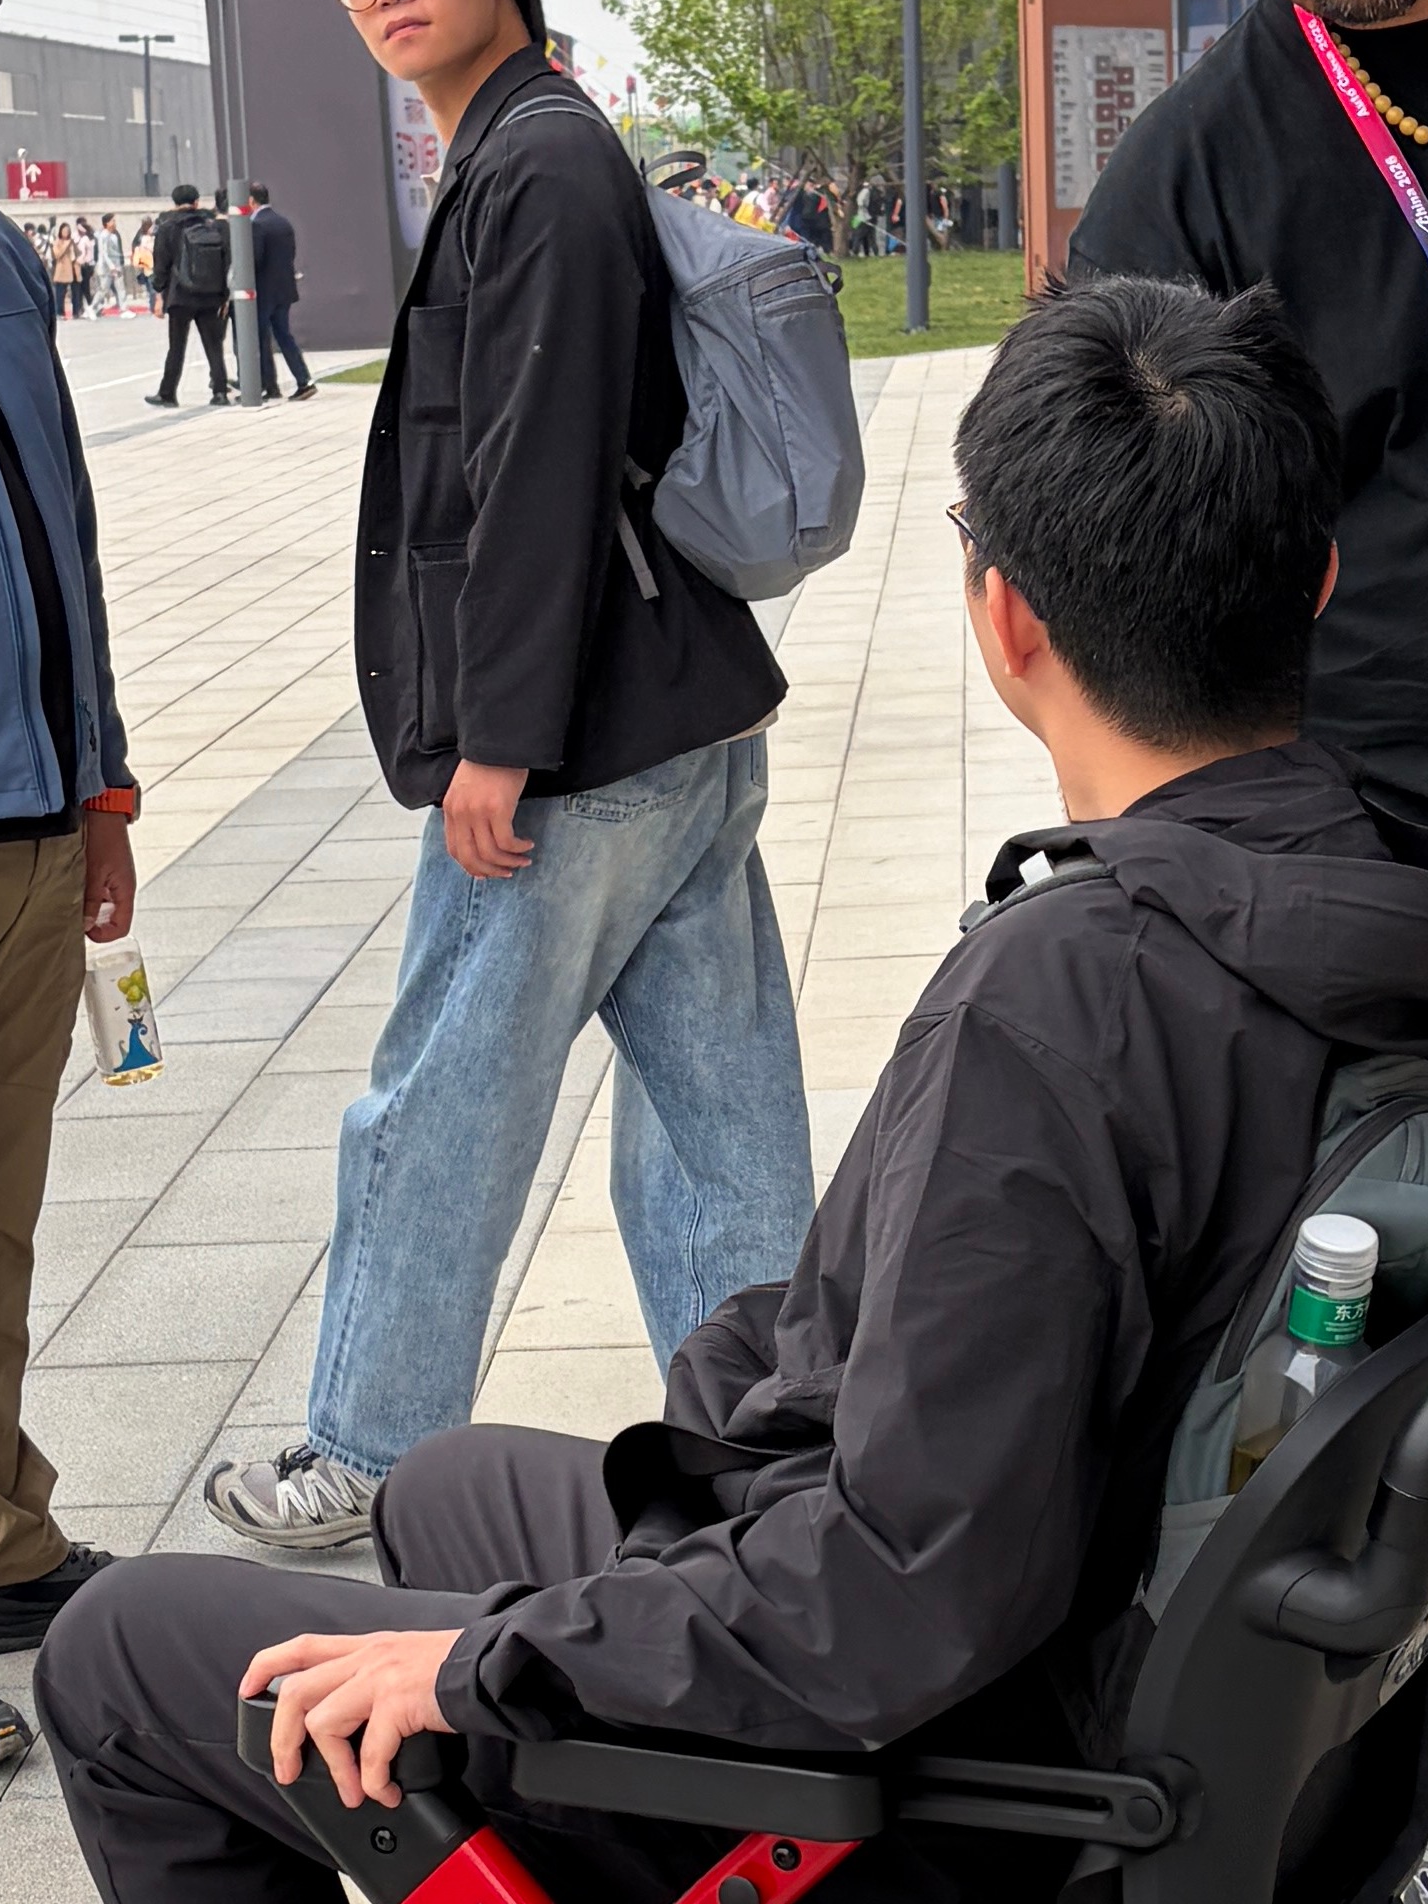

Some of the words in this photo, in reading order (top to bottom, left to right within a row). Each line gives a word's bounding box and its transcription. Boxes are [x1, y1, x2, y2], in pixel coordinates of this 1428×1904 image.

[1326, 50, 1352, 93] China
[1346, 86, 1370, 118] Auto
[1384, 154, 1412, 189] 2026
